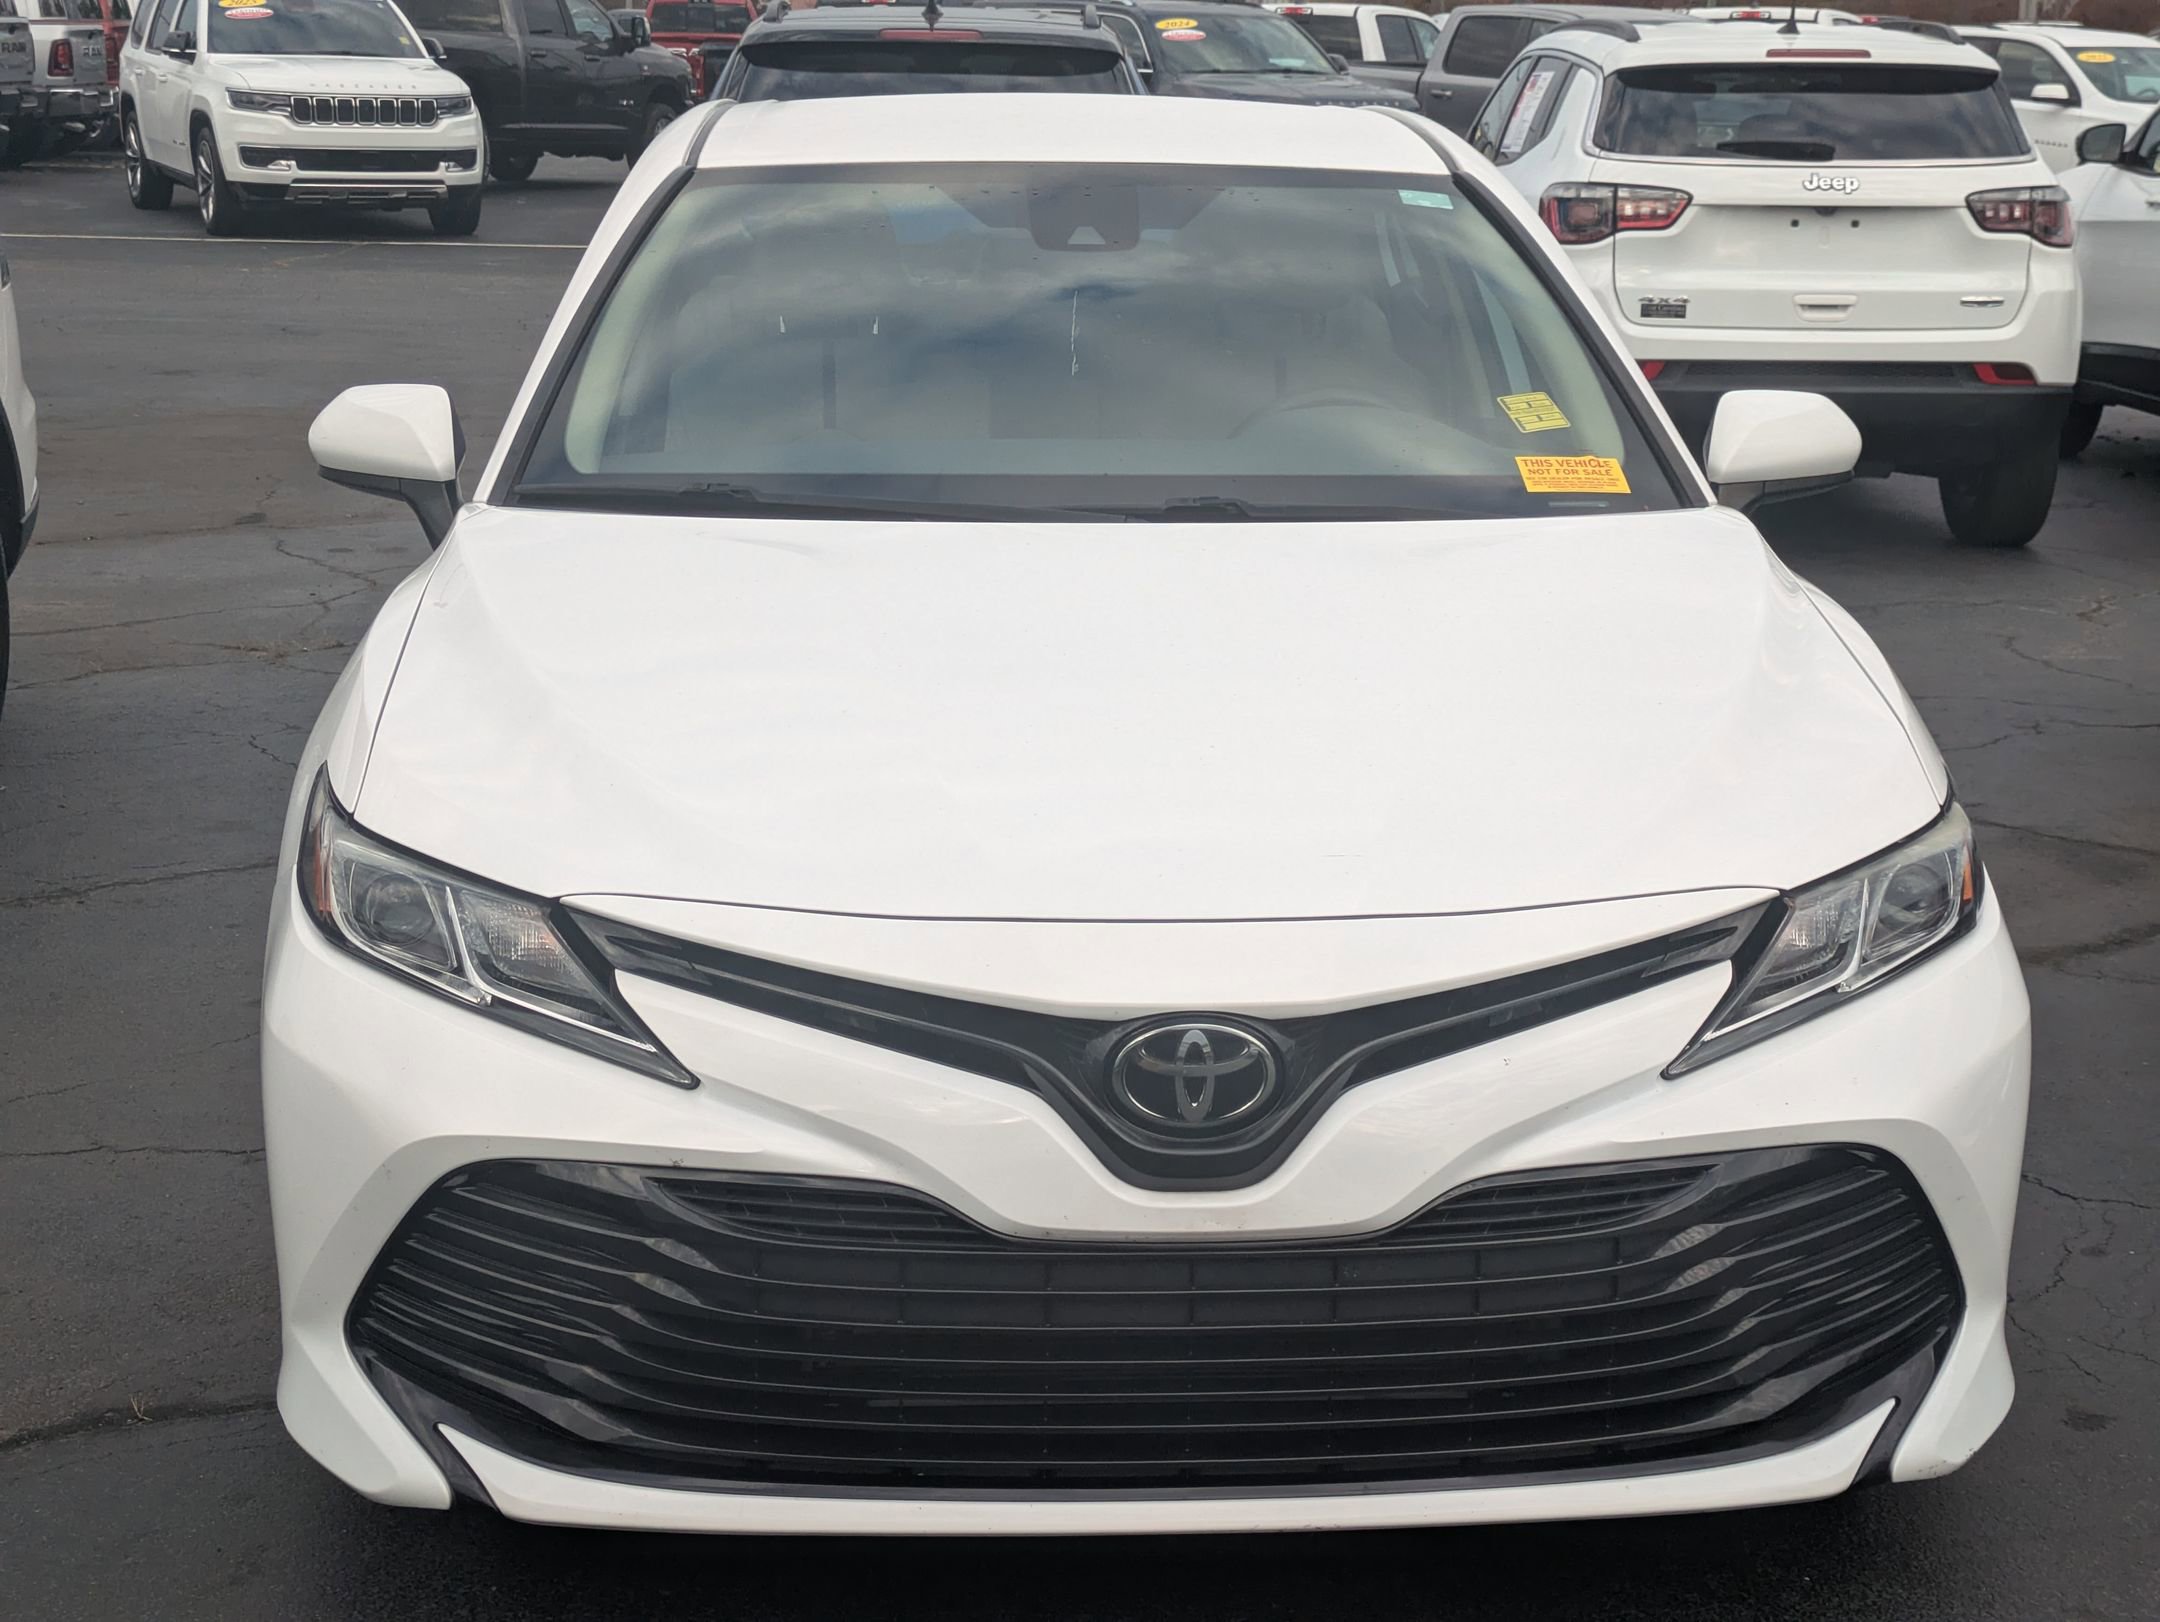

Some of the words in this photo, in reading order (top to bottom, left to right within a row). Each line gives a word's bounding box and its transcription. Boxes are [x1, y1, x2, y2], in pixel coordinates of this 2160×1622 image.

[1, 42, 27, 53] RAM
[1802, 173, 1860, 195] Jeep
[1521, 459, 1553, 468] THIS
[1555, 458, 1614, 469] VEHICLE
[1527, 468, 1551, 476] NOT
[1555, 468, 1579, 476] FOR
[1583, 468, 1614, 477] SALE
